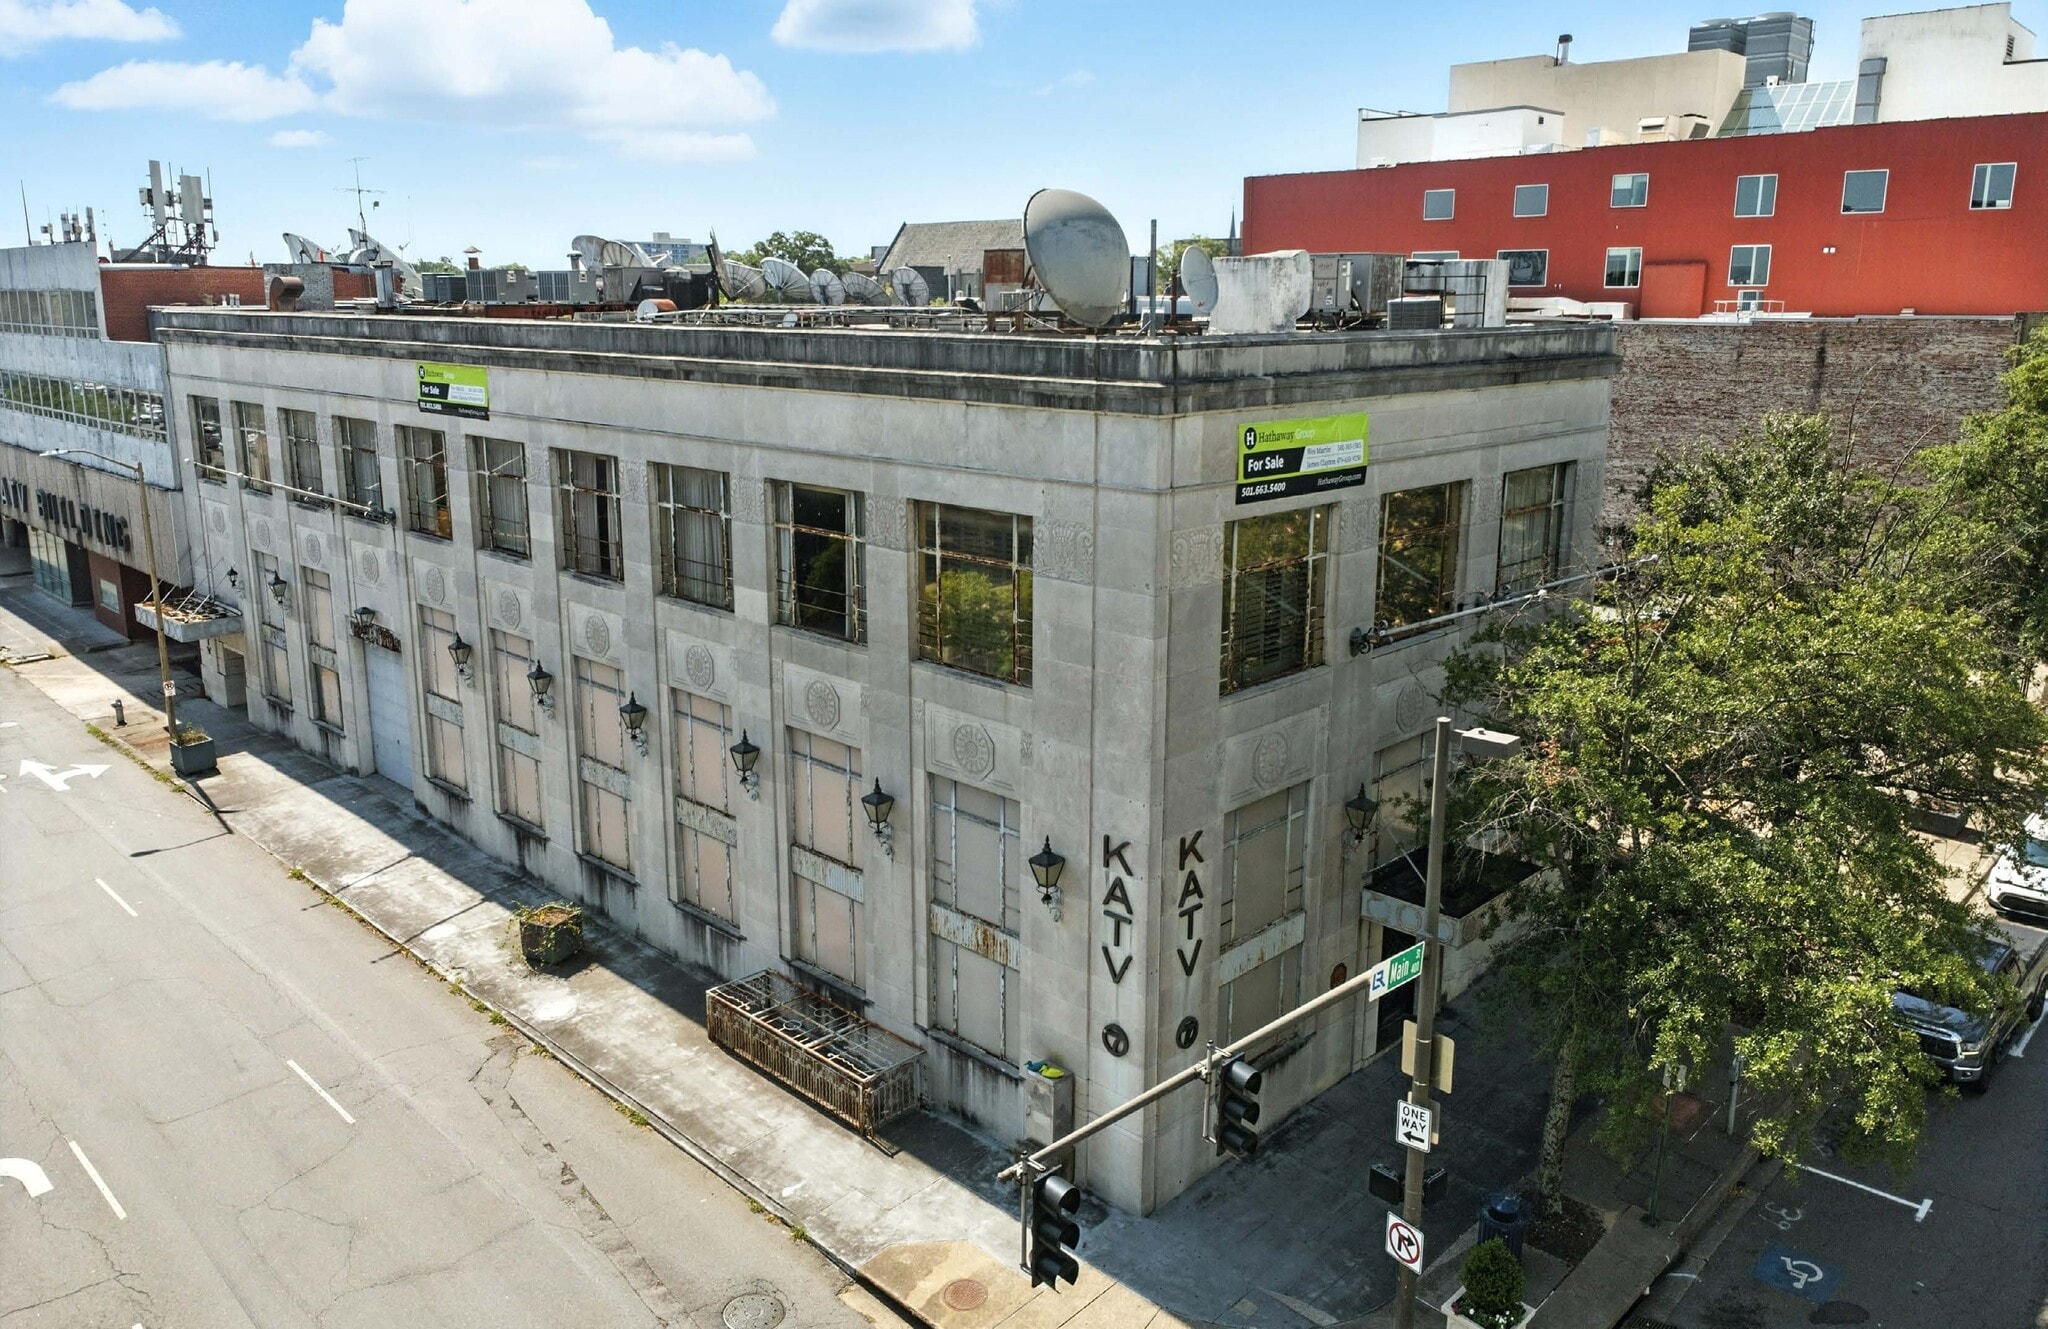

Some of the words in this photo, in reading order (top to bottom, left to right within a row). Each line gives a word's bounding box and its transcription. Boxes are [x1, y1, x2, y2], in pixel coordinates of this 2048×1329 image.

[430, 385, 439, 395] Sale
[1258, 430, 1295, 443] Hathaway
[1247, 459, 1264, 472] For
[1264, 455, 1284, 470] Sale
[1241, 482, 1287, 497] 501.663.5400
[1102, 834, 1134, 984] KATV
[1177, 830, 1204, 977] KATV
[1389, 957, 1409, 984] Main
[1402, 1105, 1426, 1123] ONE
[1401, 1116, 1427, 1133] WAY
